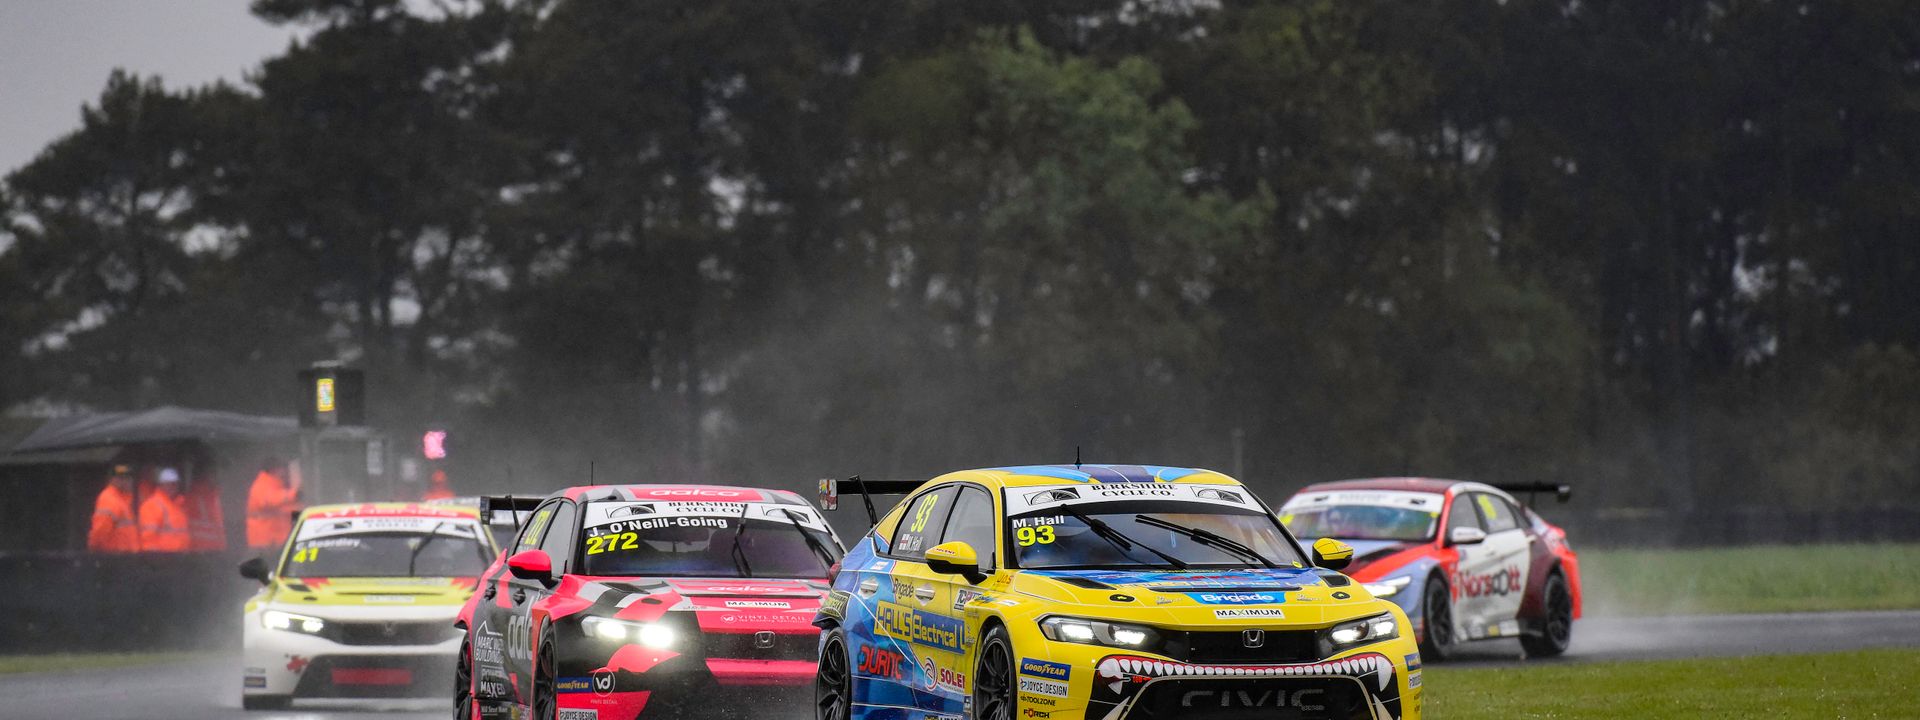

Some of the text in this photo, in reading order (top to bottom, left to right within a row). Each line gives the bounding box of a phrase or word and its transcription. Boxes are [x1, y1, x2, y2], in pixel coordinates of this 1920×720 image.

[650, 489, 741, 497] aalco
[1092, 483, 1176, 491] BERKSHIRE
[1102, 490, 1175, 498] CYCLE CO.
[911, 494, 938, 533] 93
[590, 517, 728, 537] J. O'Neill-Going
[1013, 515, 1065, 528] M. Hall
[1017, 525, 1056, 546] 93
[586, 532, 639, 555] 272
[293, 547, 319, 563] 41
[894, 578, 914, 599] Brigade
[1200, 593, 1274, 603] Brigade
[913, 615, 957, 648] Electrical
[1024, 663, 1066, 676] GOODYEAR
[481, 682, 506, 698] MAXED
[557, 680, 589, 689] GOODYEAR
[1027, 681, 1067, 696] JOYCE DESIGN
[1027, 696, 1056, 706] TOOLZONE
[1182, 689, 1324, 710] CIVIC
